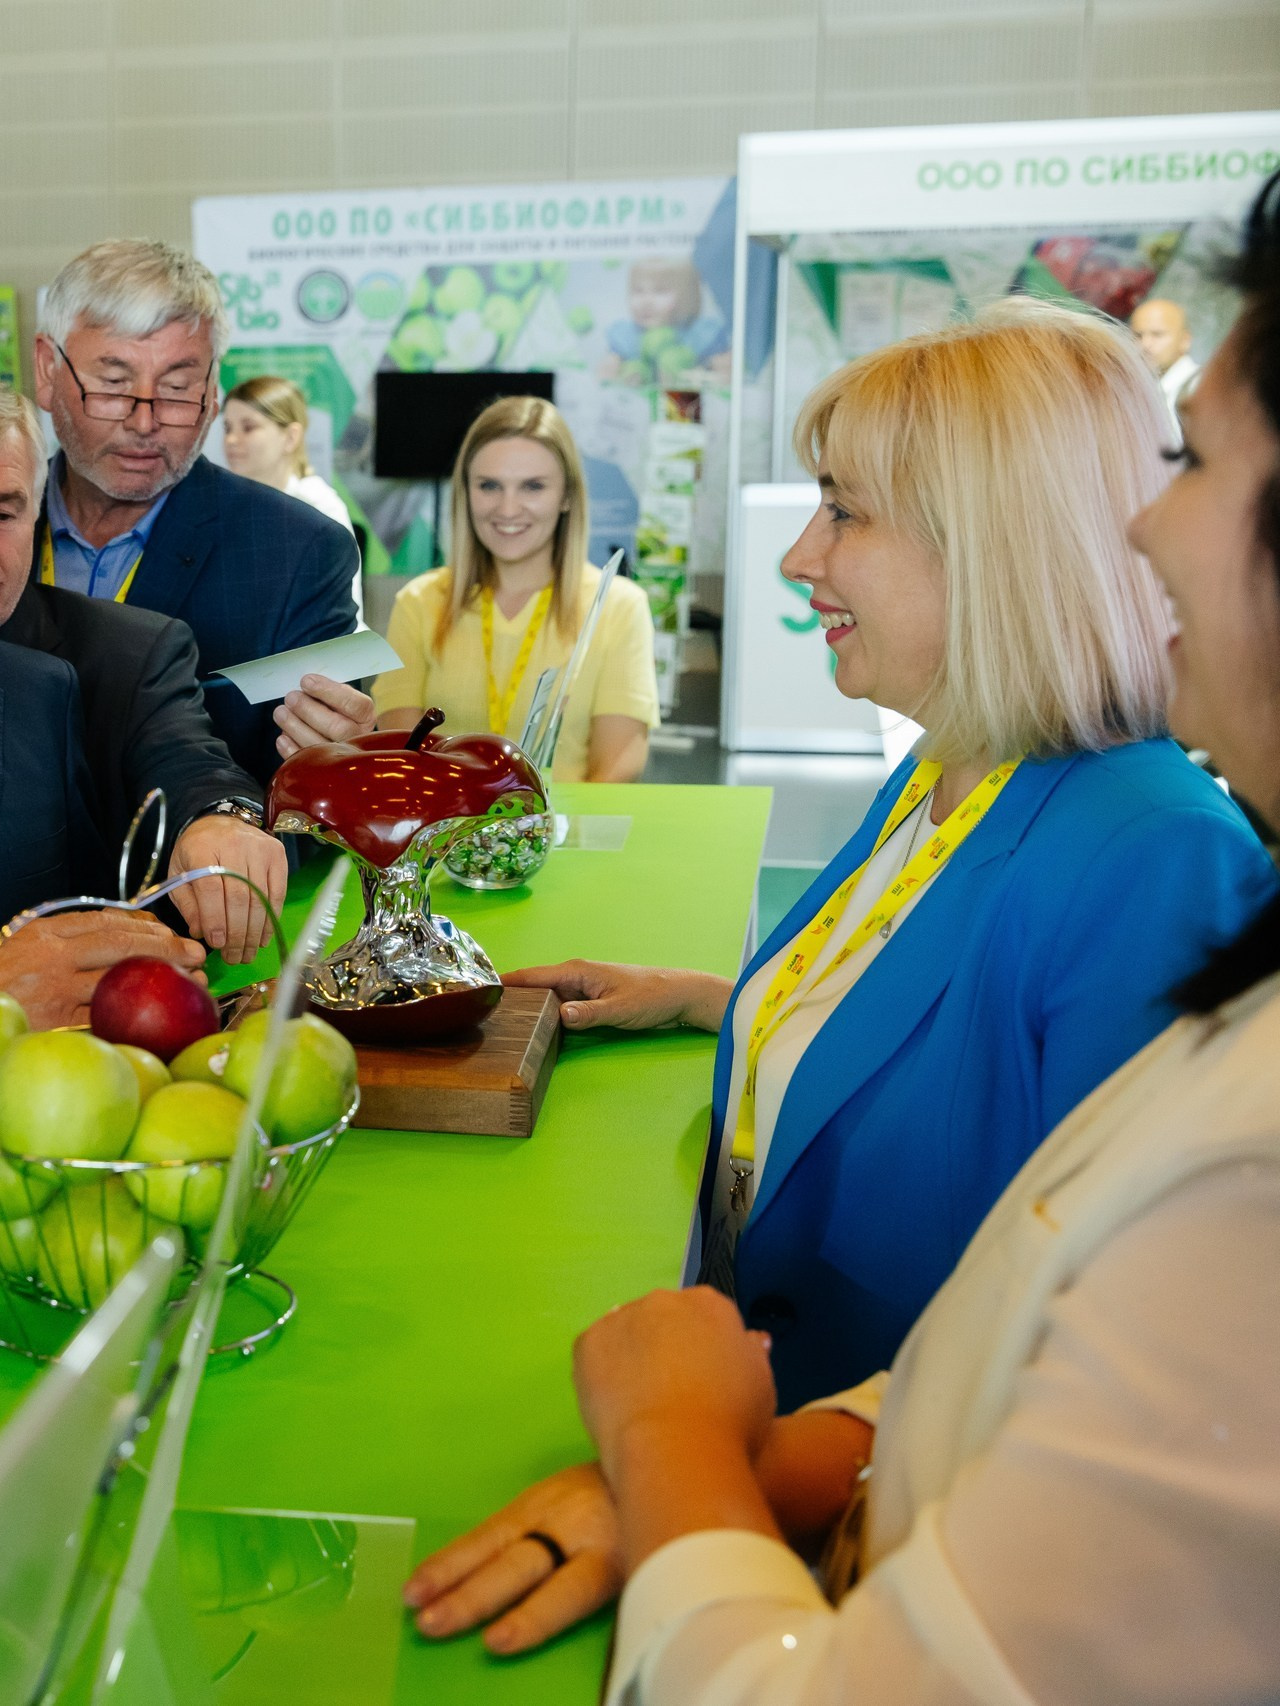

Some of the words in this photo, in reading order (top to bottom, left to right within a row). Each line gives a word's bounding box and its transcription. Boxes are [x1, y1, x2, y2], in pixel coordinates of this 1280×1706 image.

[917, 160, 1003, 191] ООО
[1015, 155, 1071, 188] ПО
[272, 208, 338, 240] ООО
[350, 205, 393, 237] ПО
[405, 195, 686, 235] «СИББИОФАРМ»
